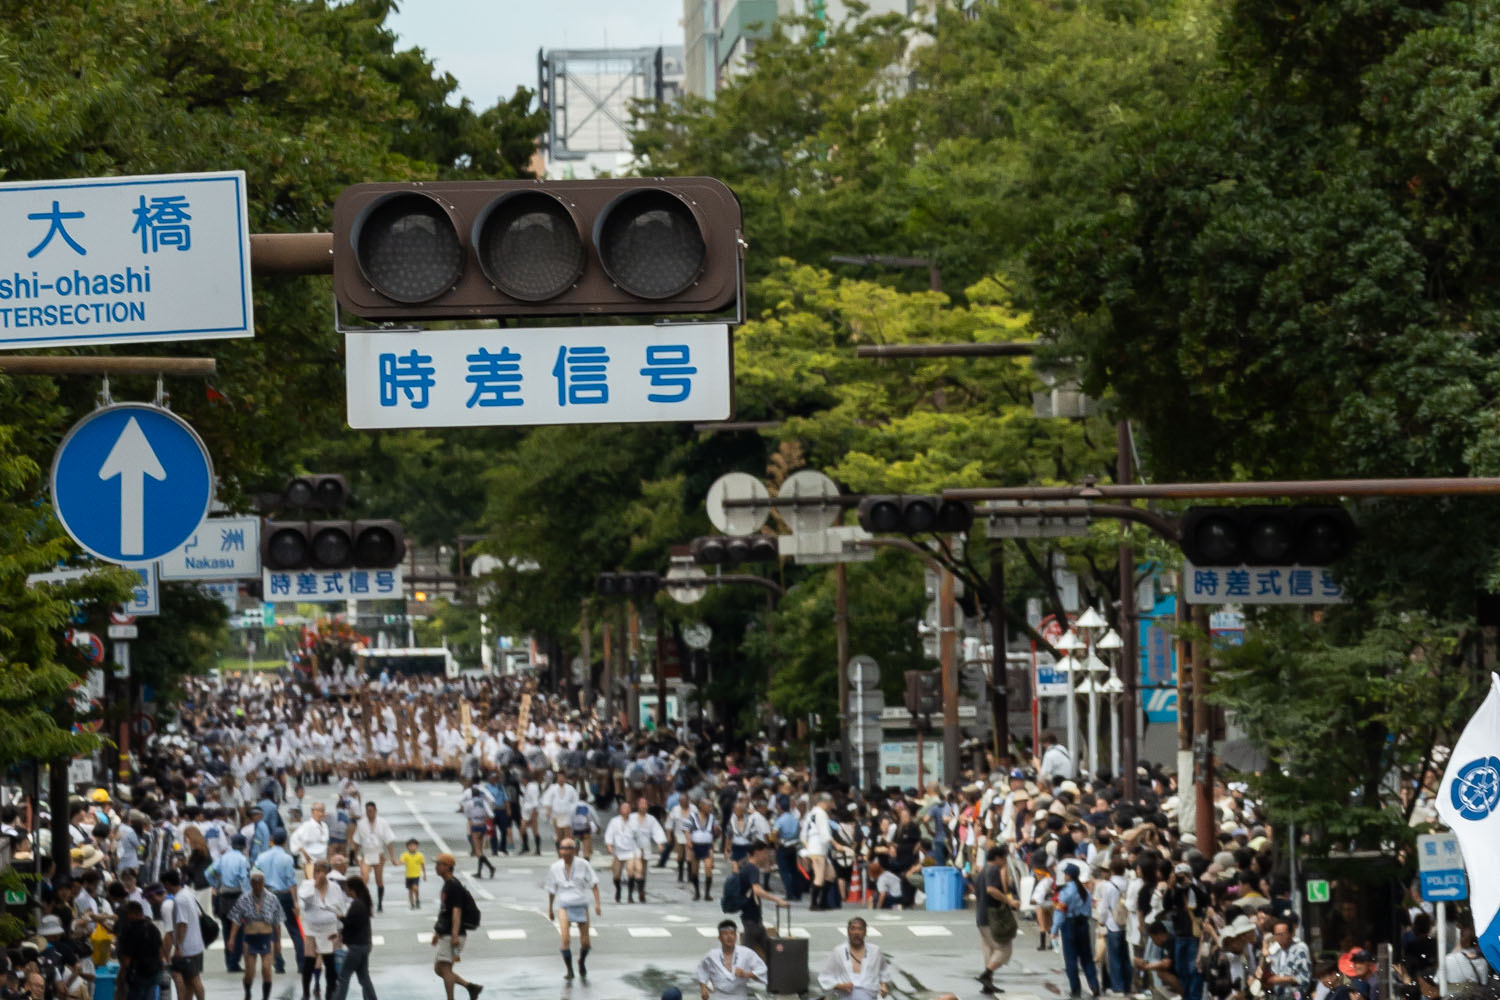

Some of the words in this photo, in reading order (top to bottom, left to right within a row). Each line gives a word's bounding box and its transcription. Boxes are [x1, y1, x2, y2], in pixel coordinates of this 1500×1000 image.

[27, 195, 192, 258] 大橋
[378, 343, 698, 410] 時差信号
[185, 557, 234, 570] Nakasu
[270, 571, 396, 594] 時差式信号
